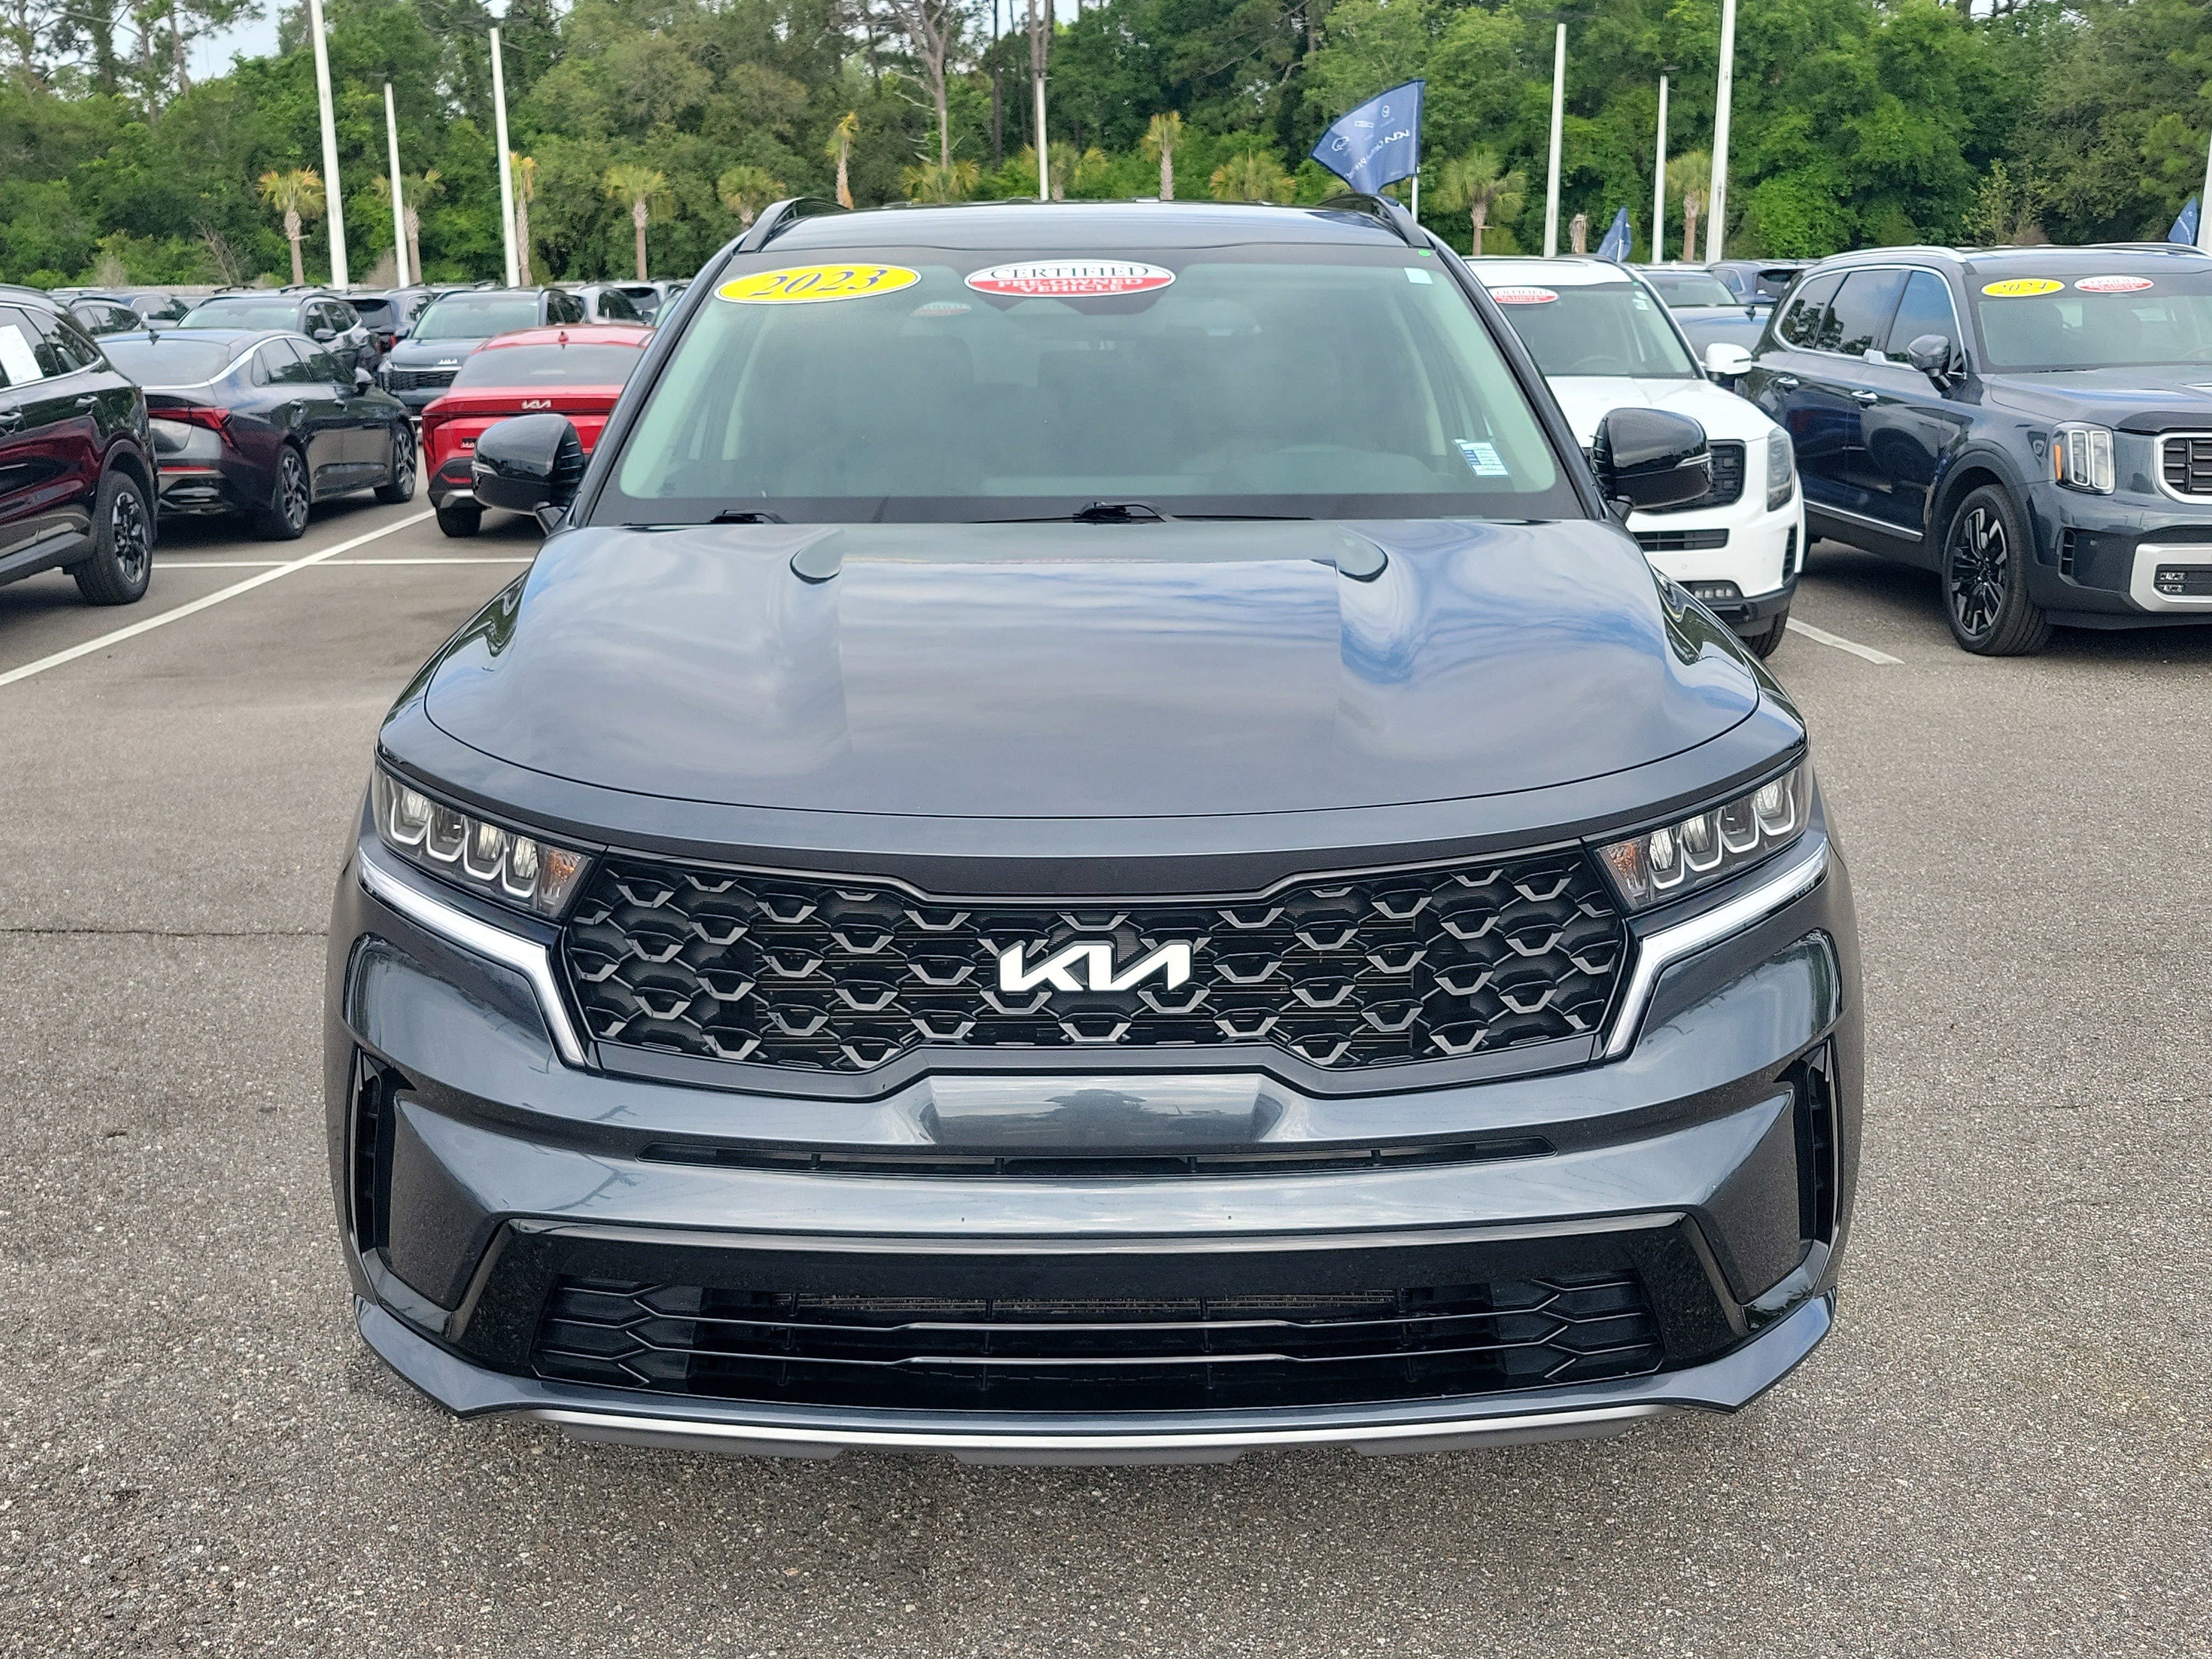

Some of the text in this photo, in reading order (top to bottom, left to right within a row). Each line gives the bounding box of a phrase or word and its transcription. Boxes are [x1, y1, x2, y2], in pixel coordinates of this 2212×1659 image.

[990, 266, 1149, 279] CERTIFIED
[747, 269, 888, 297] 2023
[997, 278, 1143, 287] PRE-OWNED
[1020, 284, 1124, 293] VEHICLE
[996, 939, 1193, 992] KIA
